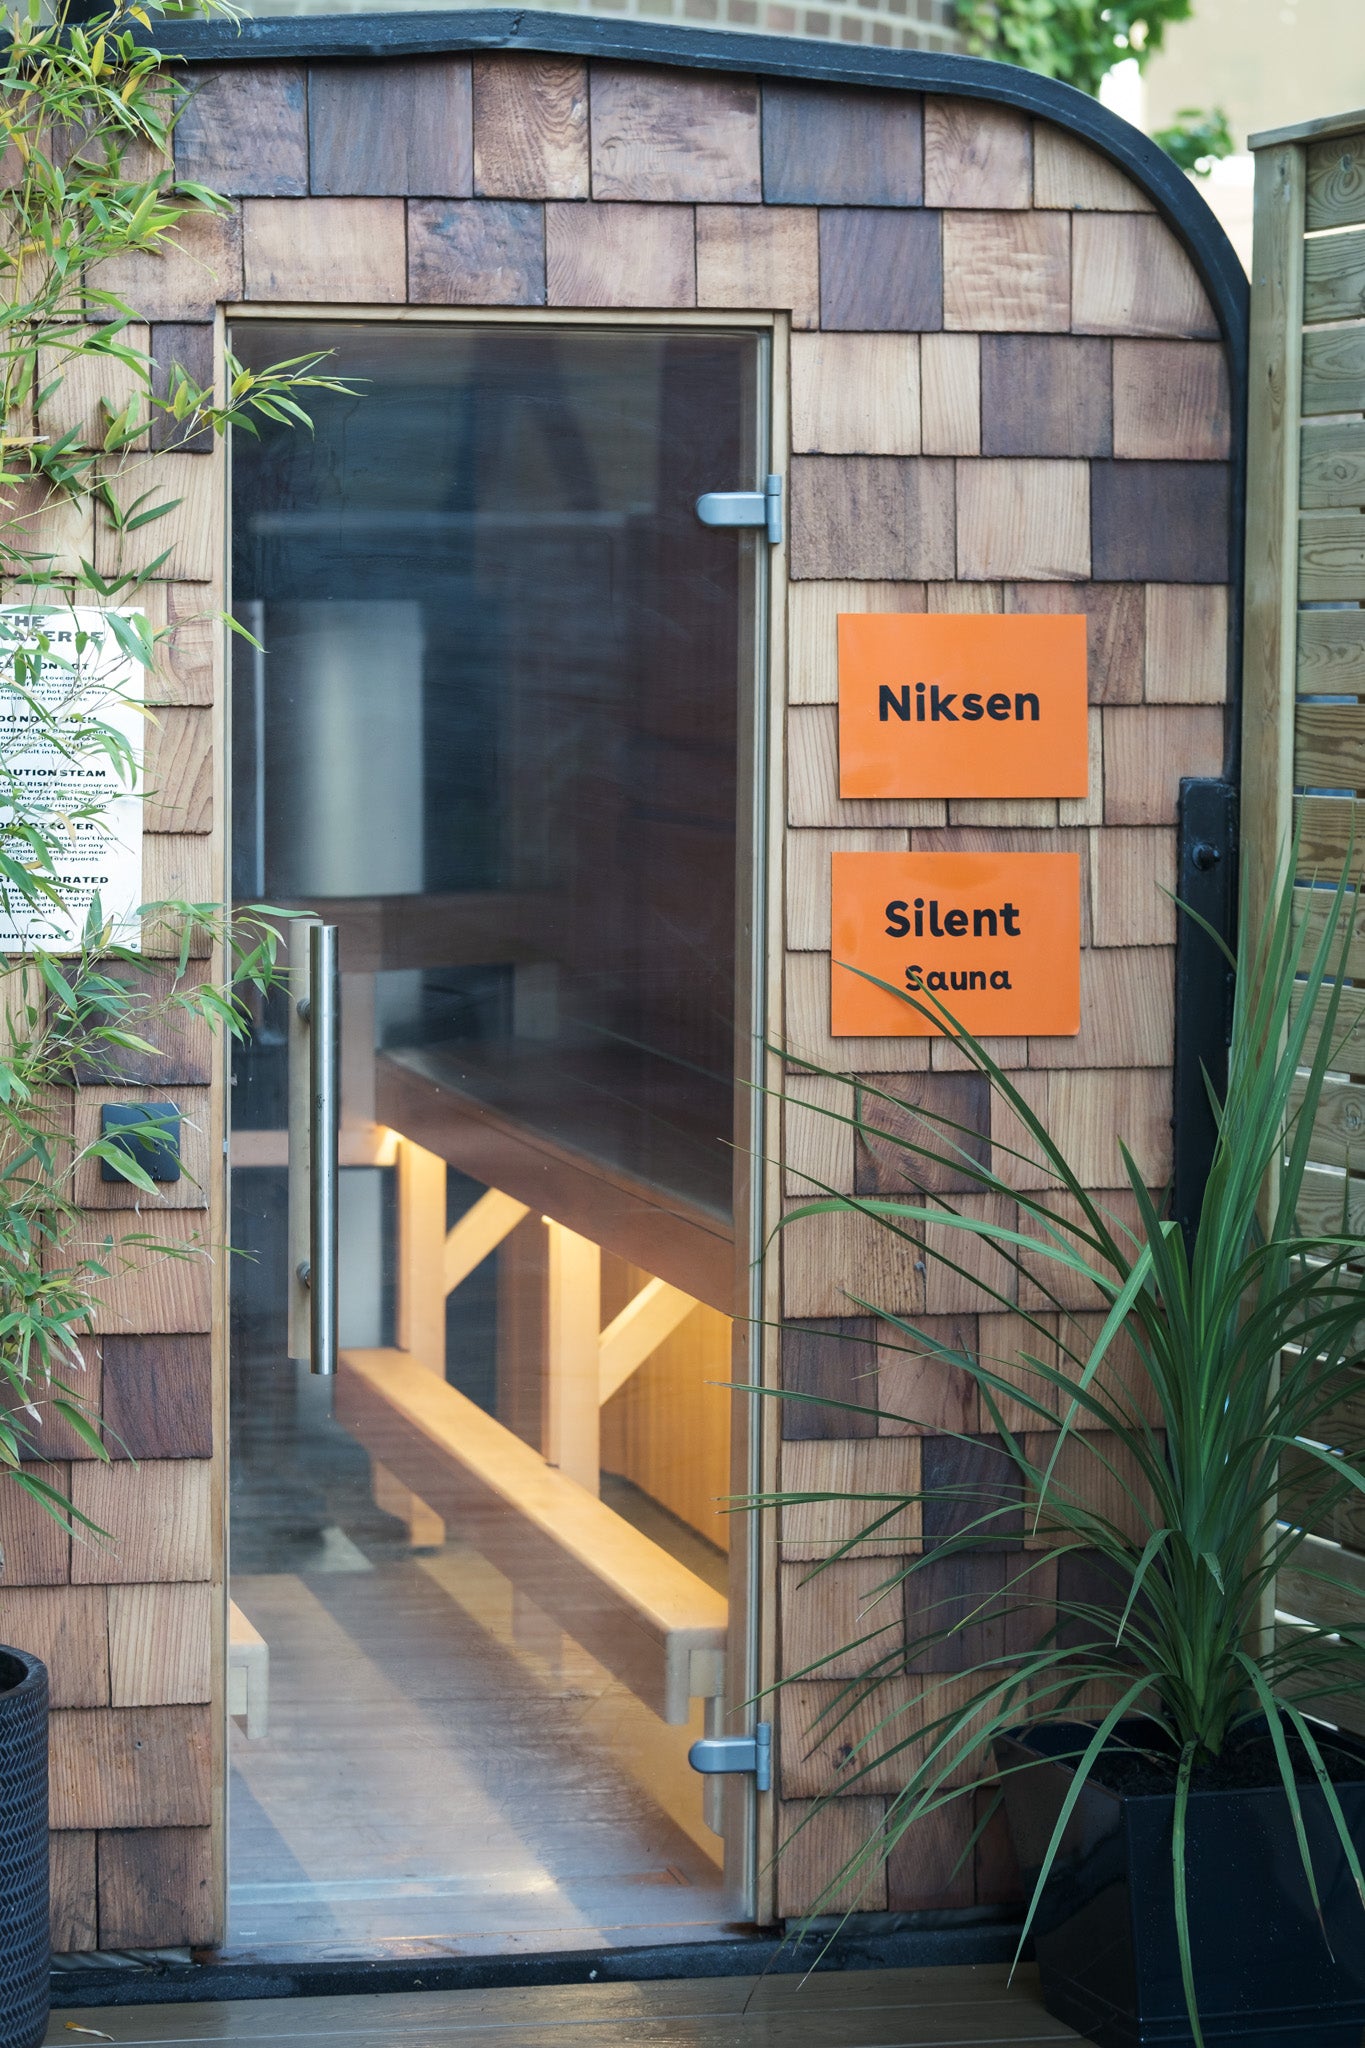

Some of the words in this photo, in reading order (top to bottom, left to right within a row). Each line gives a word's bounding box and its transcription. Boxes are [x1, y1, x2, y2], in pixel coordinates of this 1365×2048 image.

[878, 683, 1040, 722] Niksen
[7, 769, 57, 777] UTION
[60, 769, 106, 777] STEAM
[885, 898, 1021, 938] Silent
[905, 965, 1012, 991] Sauna
